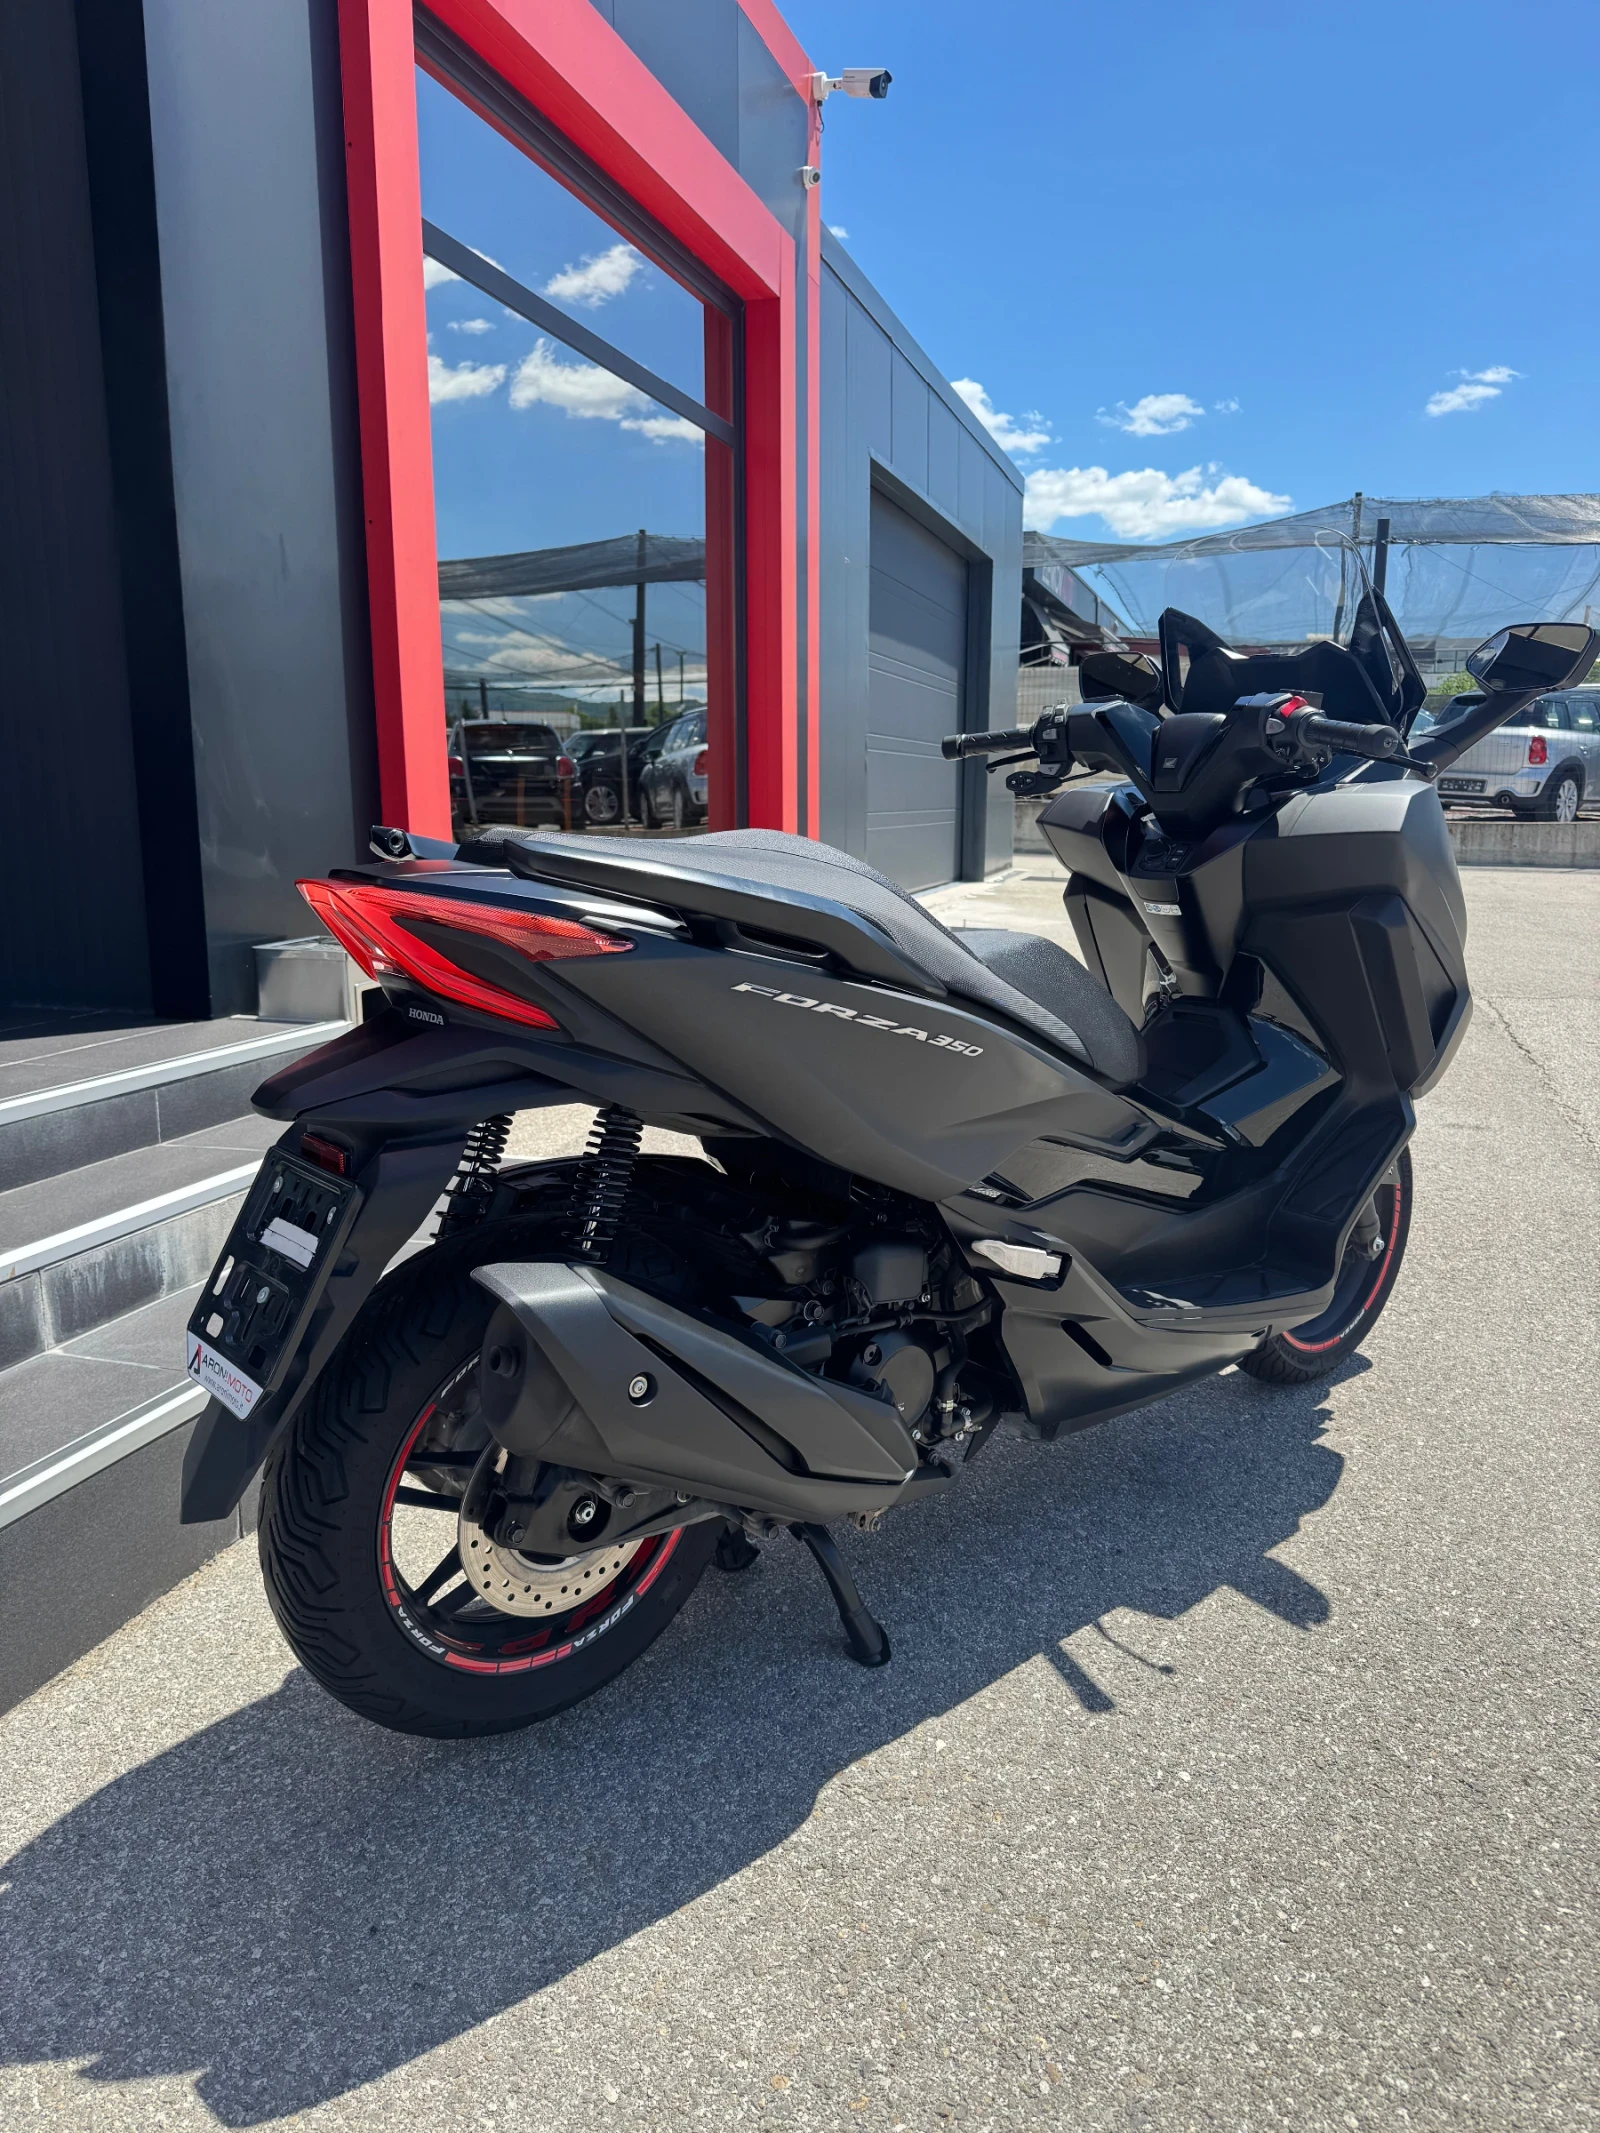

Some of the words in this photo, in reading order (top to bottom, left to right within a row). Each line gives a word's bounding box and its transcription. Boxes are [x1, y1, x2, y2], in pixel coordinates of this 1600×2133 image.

[408, 1007, 445, 1026] HONDA
[731, 981, 929, 1041] FORZA
[928, 1034, 984, 1057] 350
[440, 1354, 480, 1399] FOR
[398, 1606, 446, 1654] FORZA
[574, 1594, 634, 1647] FORZA
